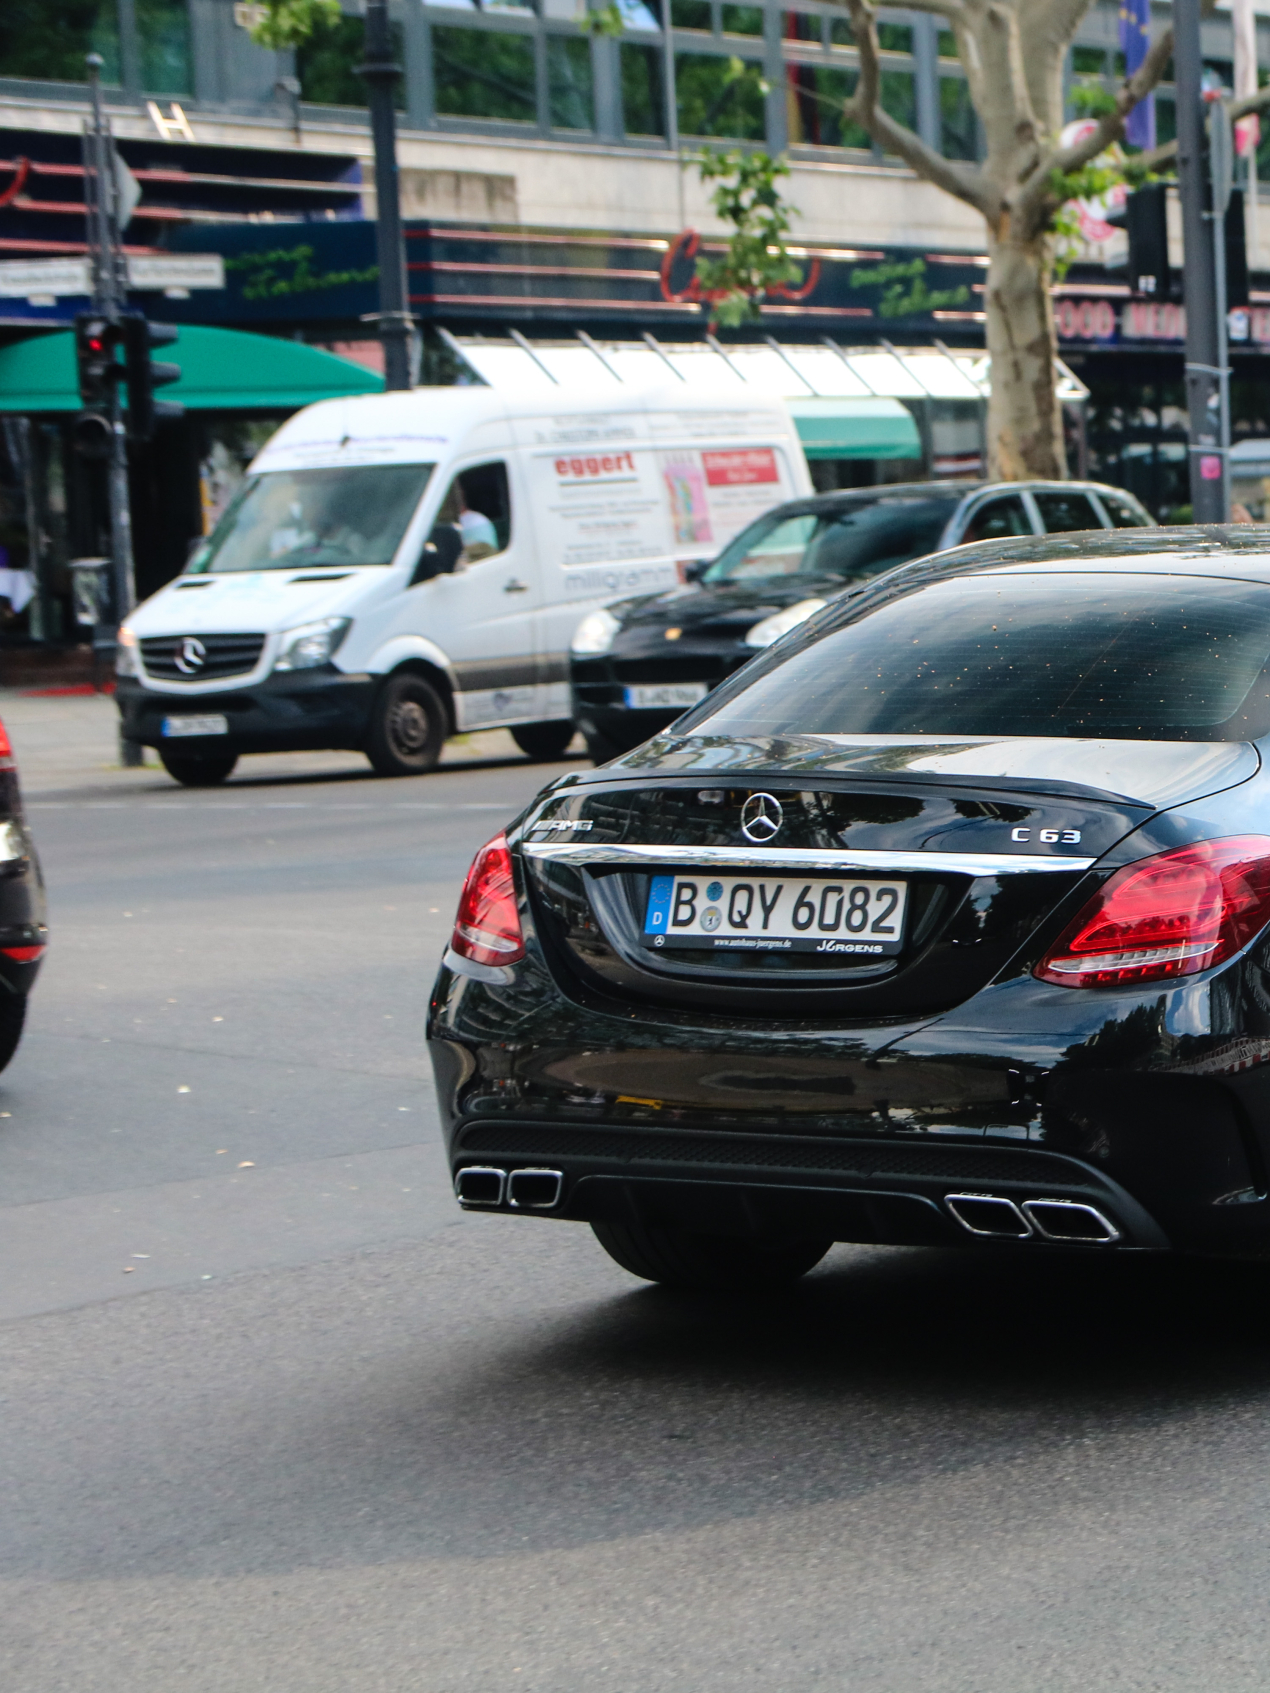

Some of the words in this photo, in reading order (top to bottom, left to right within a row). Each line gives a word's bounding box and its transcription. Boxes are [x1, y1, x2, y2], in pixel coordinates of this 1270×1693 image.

[147, 100, 196, 142] H
[554, 451, 636, 477] eggert
[1011, 827, 1031, 843] C
[1039, 828, 1082, 845] 63
[652, 911, 663, 926] D
[671, 881, 699, 928] B
[727, 883, 784, 931] QY
[791, 885, 900, 934] 6082
